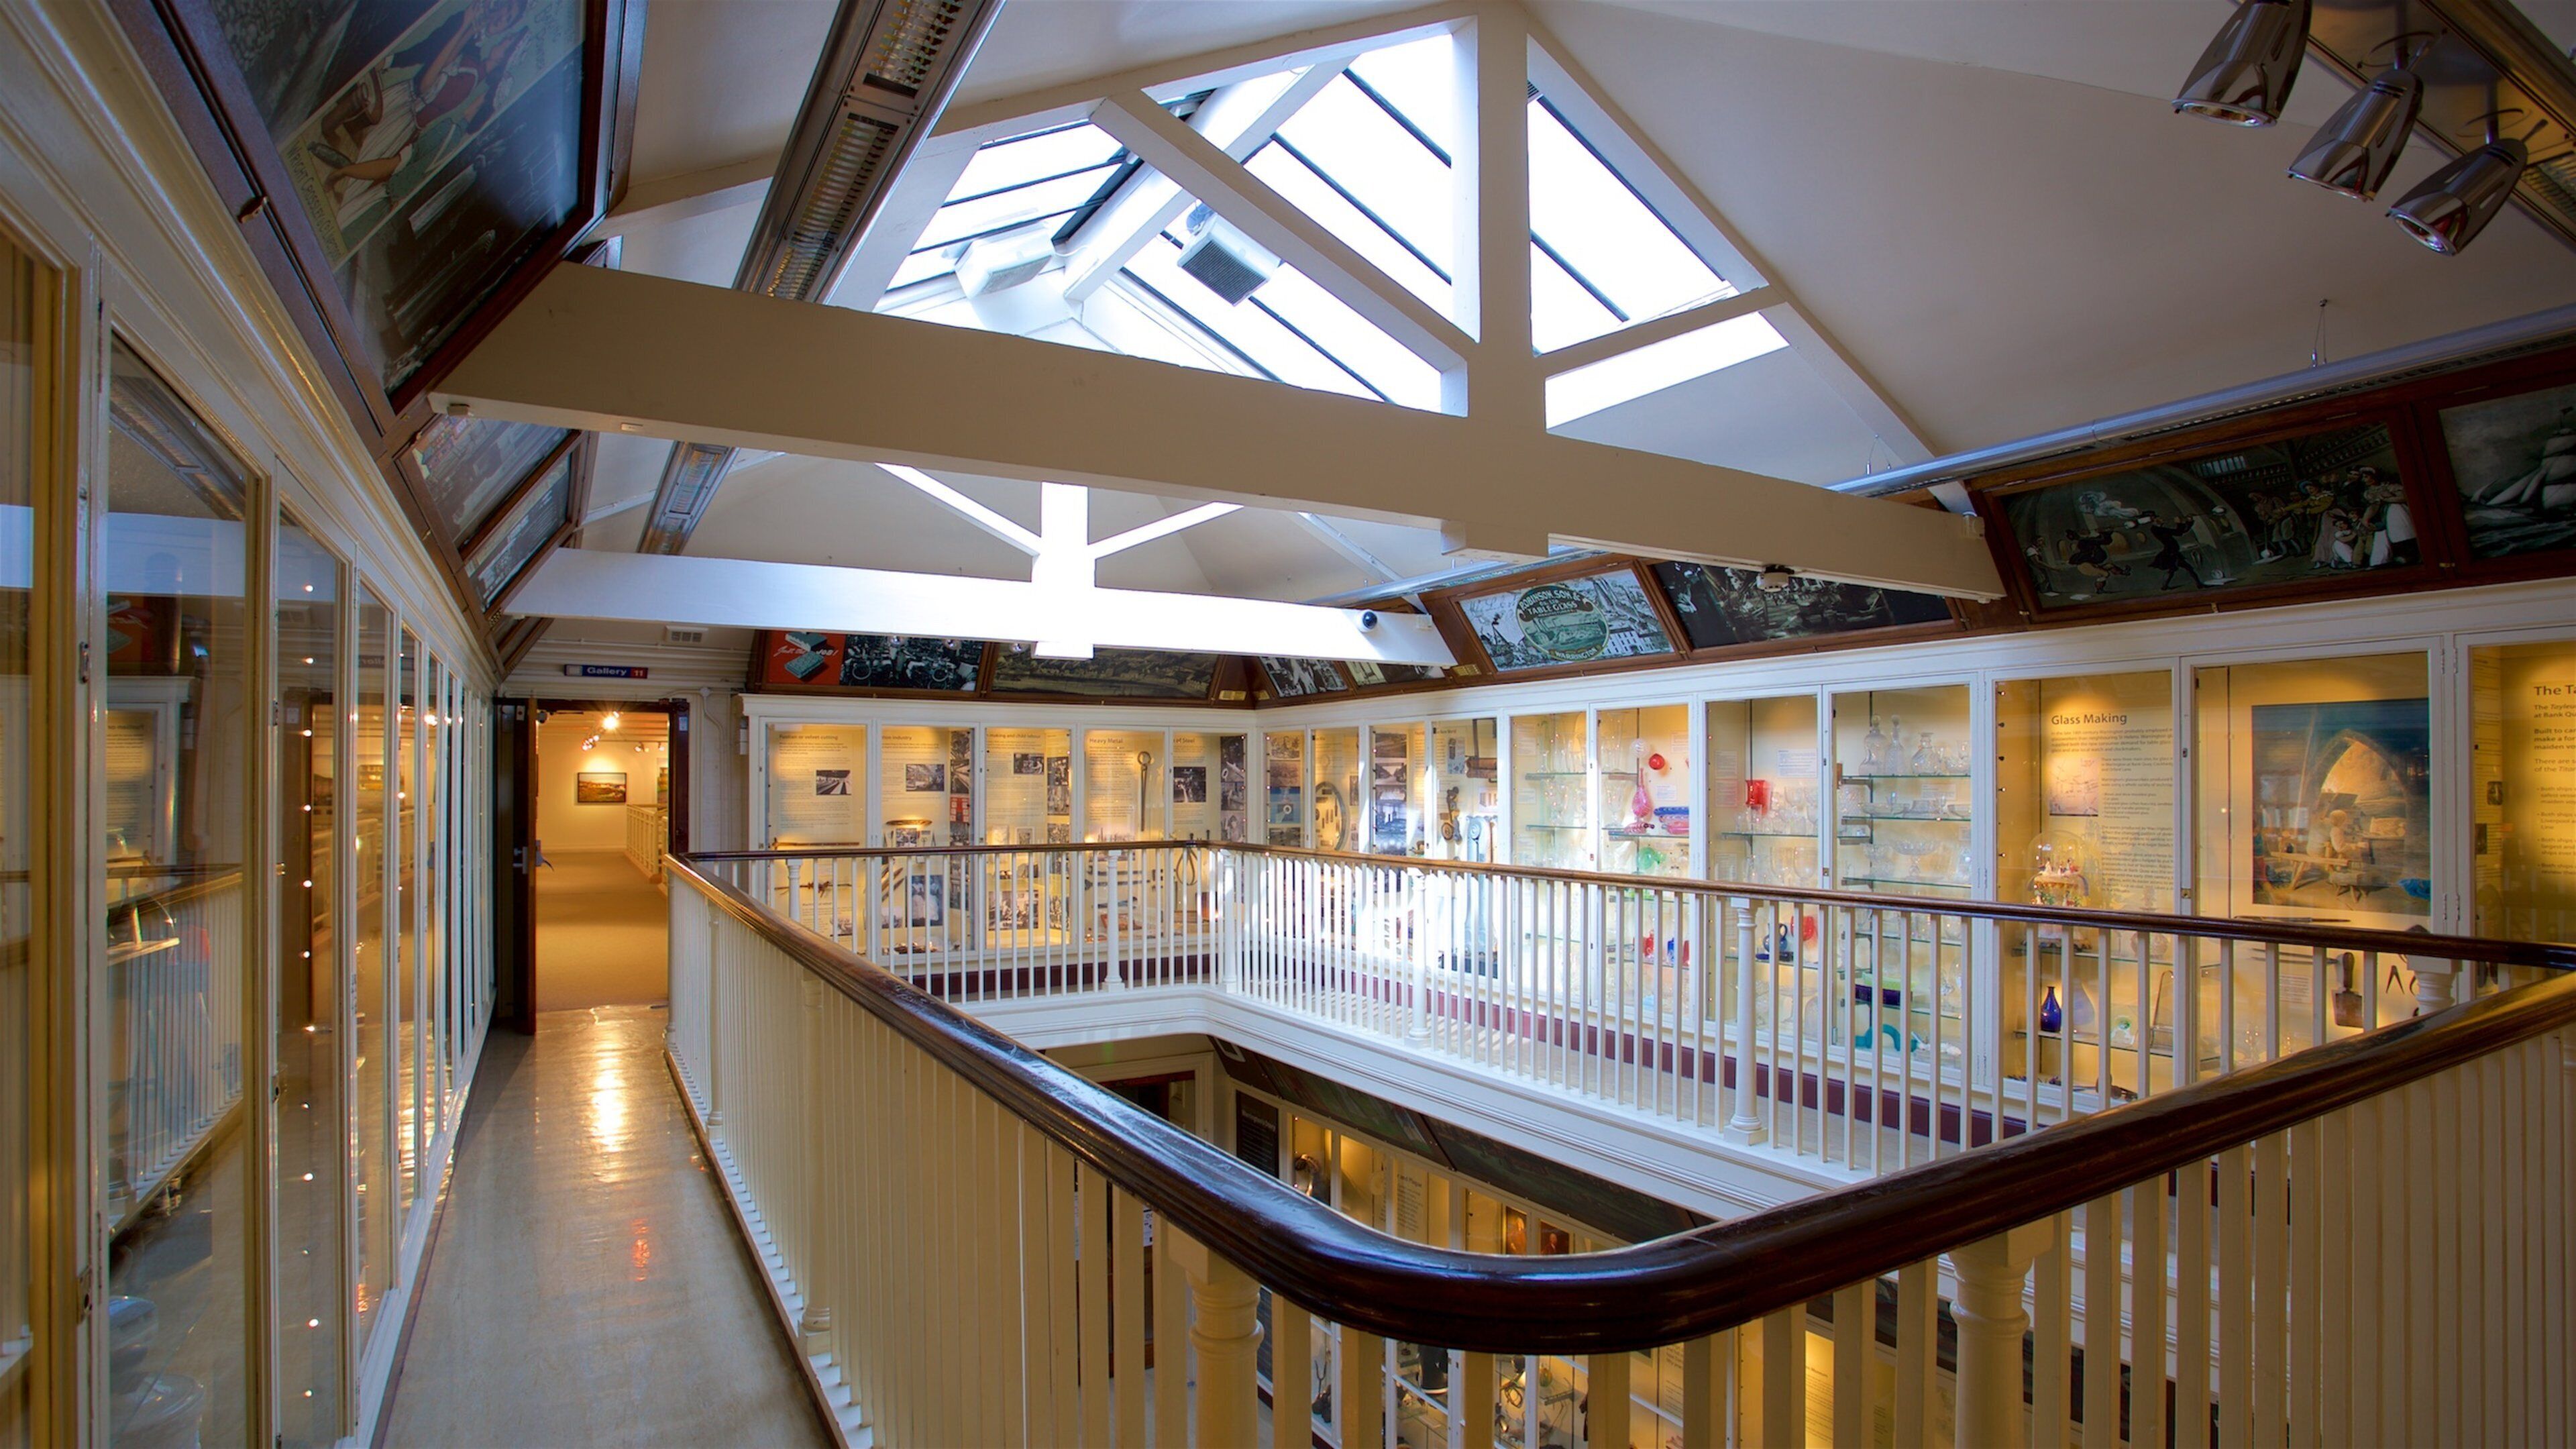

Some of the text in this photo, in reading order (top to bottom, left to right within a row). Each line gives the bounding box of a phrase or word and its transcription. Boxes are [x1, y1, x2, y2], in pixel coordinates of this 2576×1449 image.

[1527, 605, 1552, 614] TABLE
[1553, 601, 1578, 611] GLASS
[1554, 647, 1598, 660] WARRINGTON
[587, 667, 627, 676] Gallery
[2534, 686, 2561, 696] The
[2051, 713, 2127, 725] Glass Making
